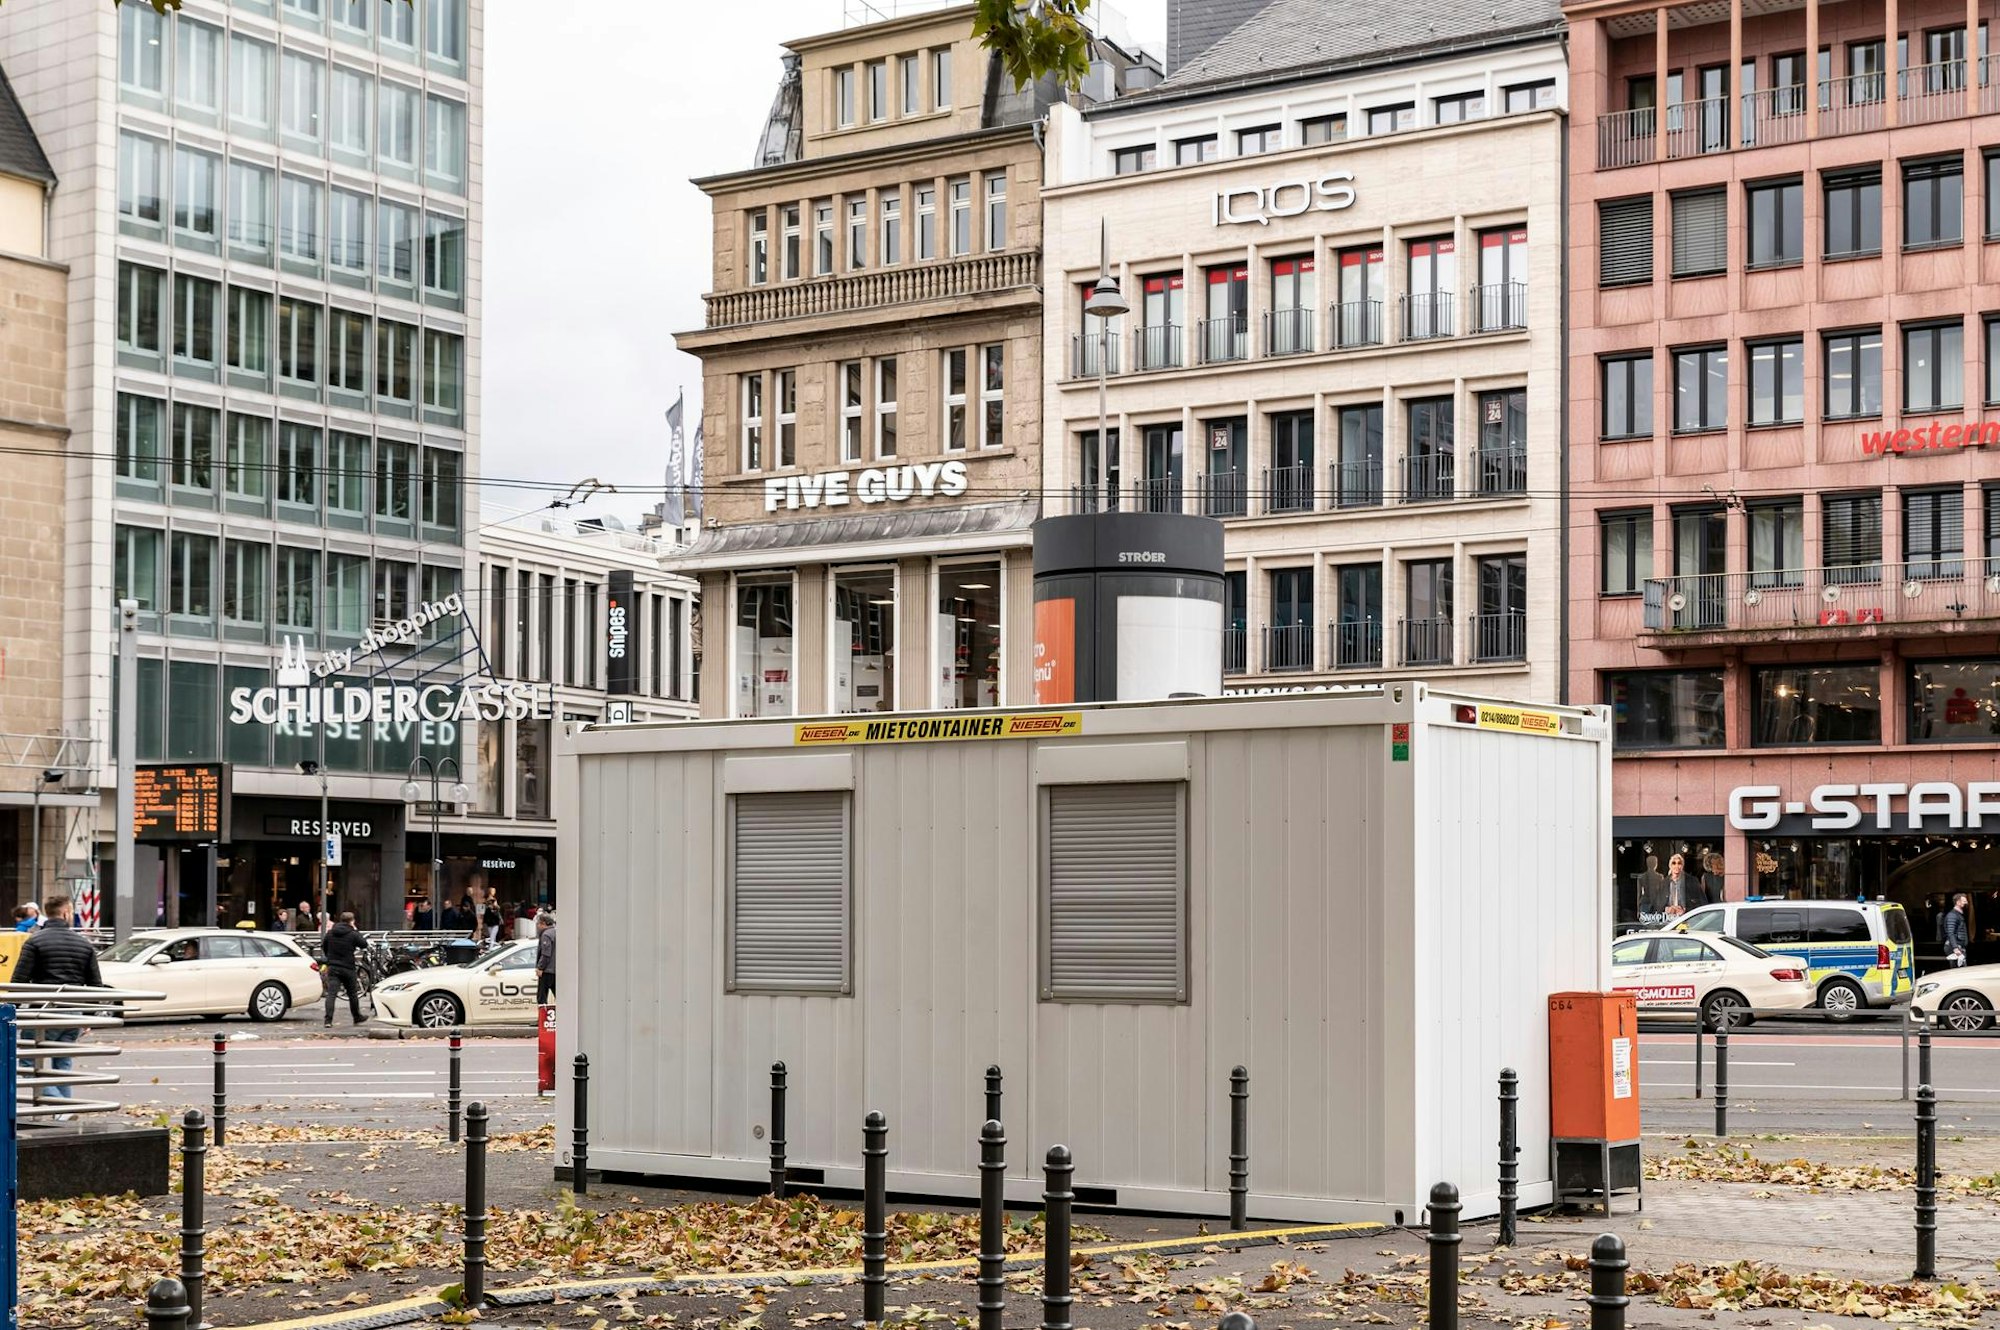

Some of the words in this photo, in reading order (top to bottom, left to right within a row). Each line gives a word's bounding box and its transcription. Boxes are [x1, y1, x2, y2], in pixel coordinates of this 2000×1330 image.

[1211, 171, 1356, 226] IQOS
[1488, 410, 1502, 421] 24
[1215, 436, 1228, 448] 24
[764, 471, 850, 512] FIVE
[856, 460, 968, 504] GUYS
[1119, 551, 1166, 563] STRÖER
[314, 647, 352, 678] city
[359, 592, 463, 655] shopping
[609, 606, 628, 658] snipes
[229, 683, 553, 725] SCHILDERGASSE
[275, 717, 456, 745] RESERVED
[865, 718, 1004, 740] MIETCONTAINER
[291, 819, 371, 837] RESERVED
[482, 859, 516, 869] RESERVED
[1625, 986, 1693, 1001] EGMÜLLER
[1550, 1000, 1573, 1011] C64
